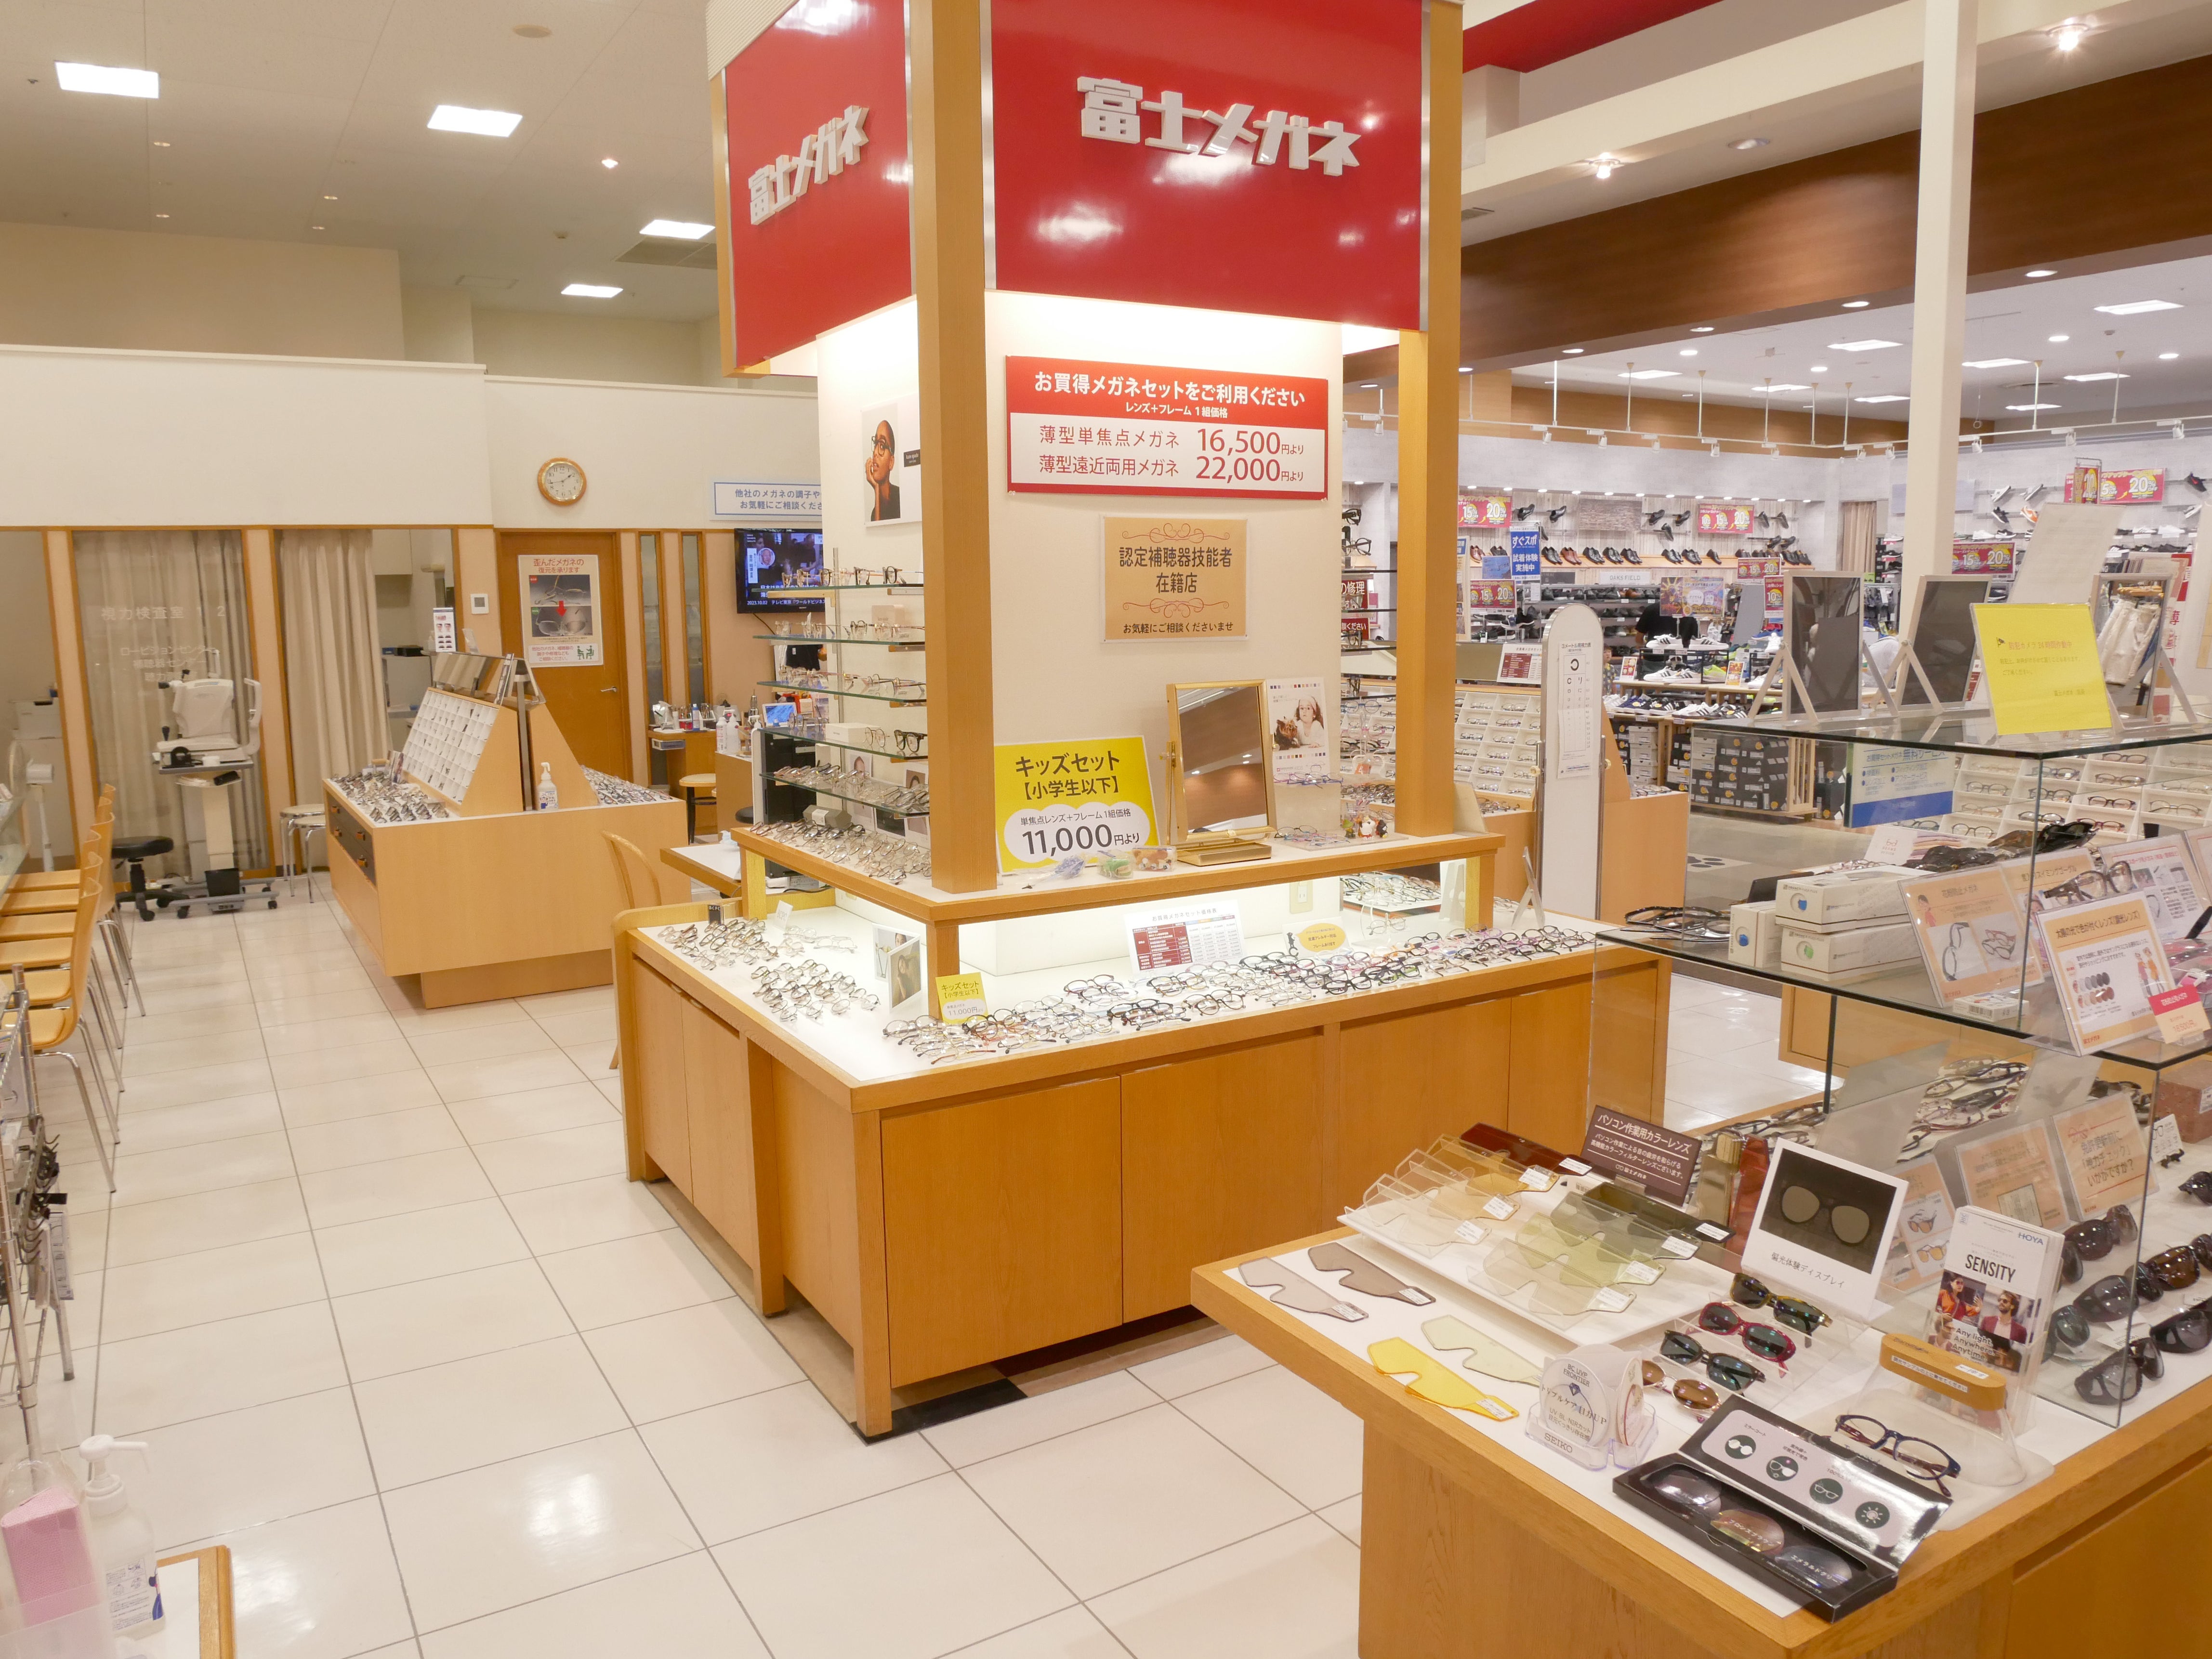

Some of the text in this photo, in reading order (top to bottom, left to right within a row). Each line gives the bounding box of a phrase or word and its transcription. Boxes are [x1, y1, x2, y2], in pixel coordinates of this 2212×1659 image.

[1077, 76, 1361, 176] 富士メガネ
[748, 105, 870, 225] 富士メガネ
[1035, 371, 1305, 407] お買得メガネセットをご利用ください
[1195, 407, 1228, 418] 1組価格
[1040, 425, 1304, 455] 薄型単焦点メガネ 16,500円より
[1040, 455, 1304, 483] 薄型遠近両用メガネ 22,000円より
[735, 489, 821, 499] 他社のメガネの調子や
[1513, 535, 1537, 548] すぐスポ
[534, 558, 584, 566] 歪んだメガネの
[1119, 547, 1232, 567] 認定補聴器技能者
[1513, 553, 1538, 562] 試着体験
[1157, 572, 1198, 593] 在籍店
[101, 606, 184, 620] 視力検査室
[218, 606, 225, 616] 2
[1123, 622, 1233, 633] お気軽にご相談くださいませ
[1016, 750, 1120, 777] キッズセット
[1024, 776, 1119, 800] 【小学生以下】
[1104, 808, 1131, 820] 1組価格
[1022, 824, 1140, 856] 11,000円より
[941, 981, 979, 991] キッズセット
[1597, 1114, 1692, 1154] パソコン作業用カラーレンズ
[1591, 1139, 1683, 1179] 高機能カラーフィルターレンズございます。
[1595, 1133, 1681, 1169] パソコン作業による目の疲労を和らげる
[1624, 1168, 1647, 1179] 富士メガネ
[2018, 1232, 2044, 1245] HOYA
[1771, 1252, 1845, 1288] 偏光体験ディスプレイ
[1965, 1254, 2016, 1283] SENSITY
[1954, 1336, 1995, 1356] Anywhere.
[1956, 1328, 1994, 1346] Any light.
[1952, 1343, 1988, 1362] Anytime.
[1563, 1369, 1590, 1387] FRONTIER
[1567, 1364, 1588, 1377] BC UVP
[1541, 1384, 1577, 1409] トリプルケア
[1544, 1433, 1573, 1453] SEIKO
